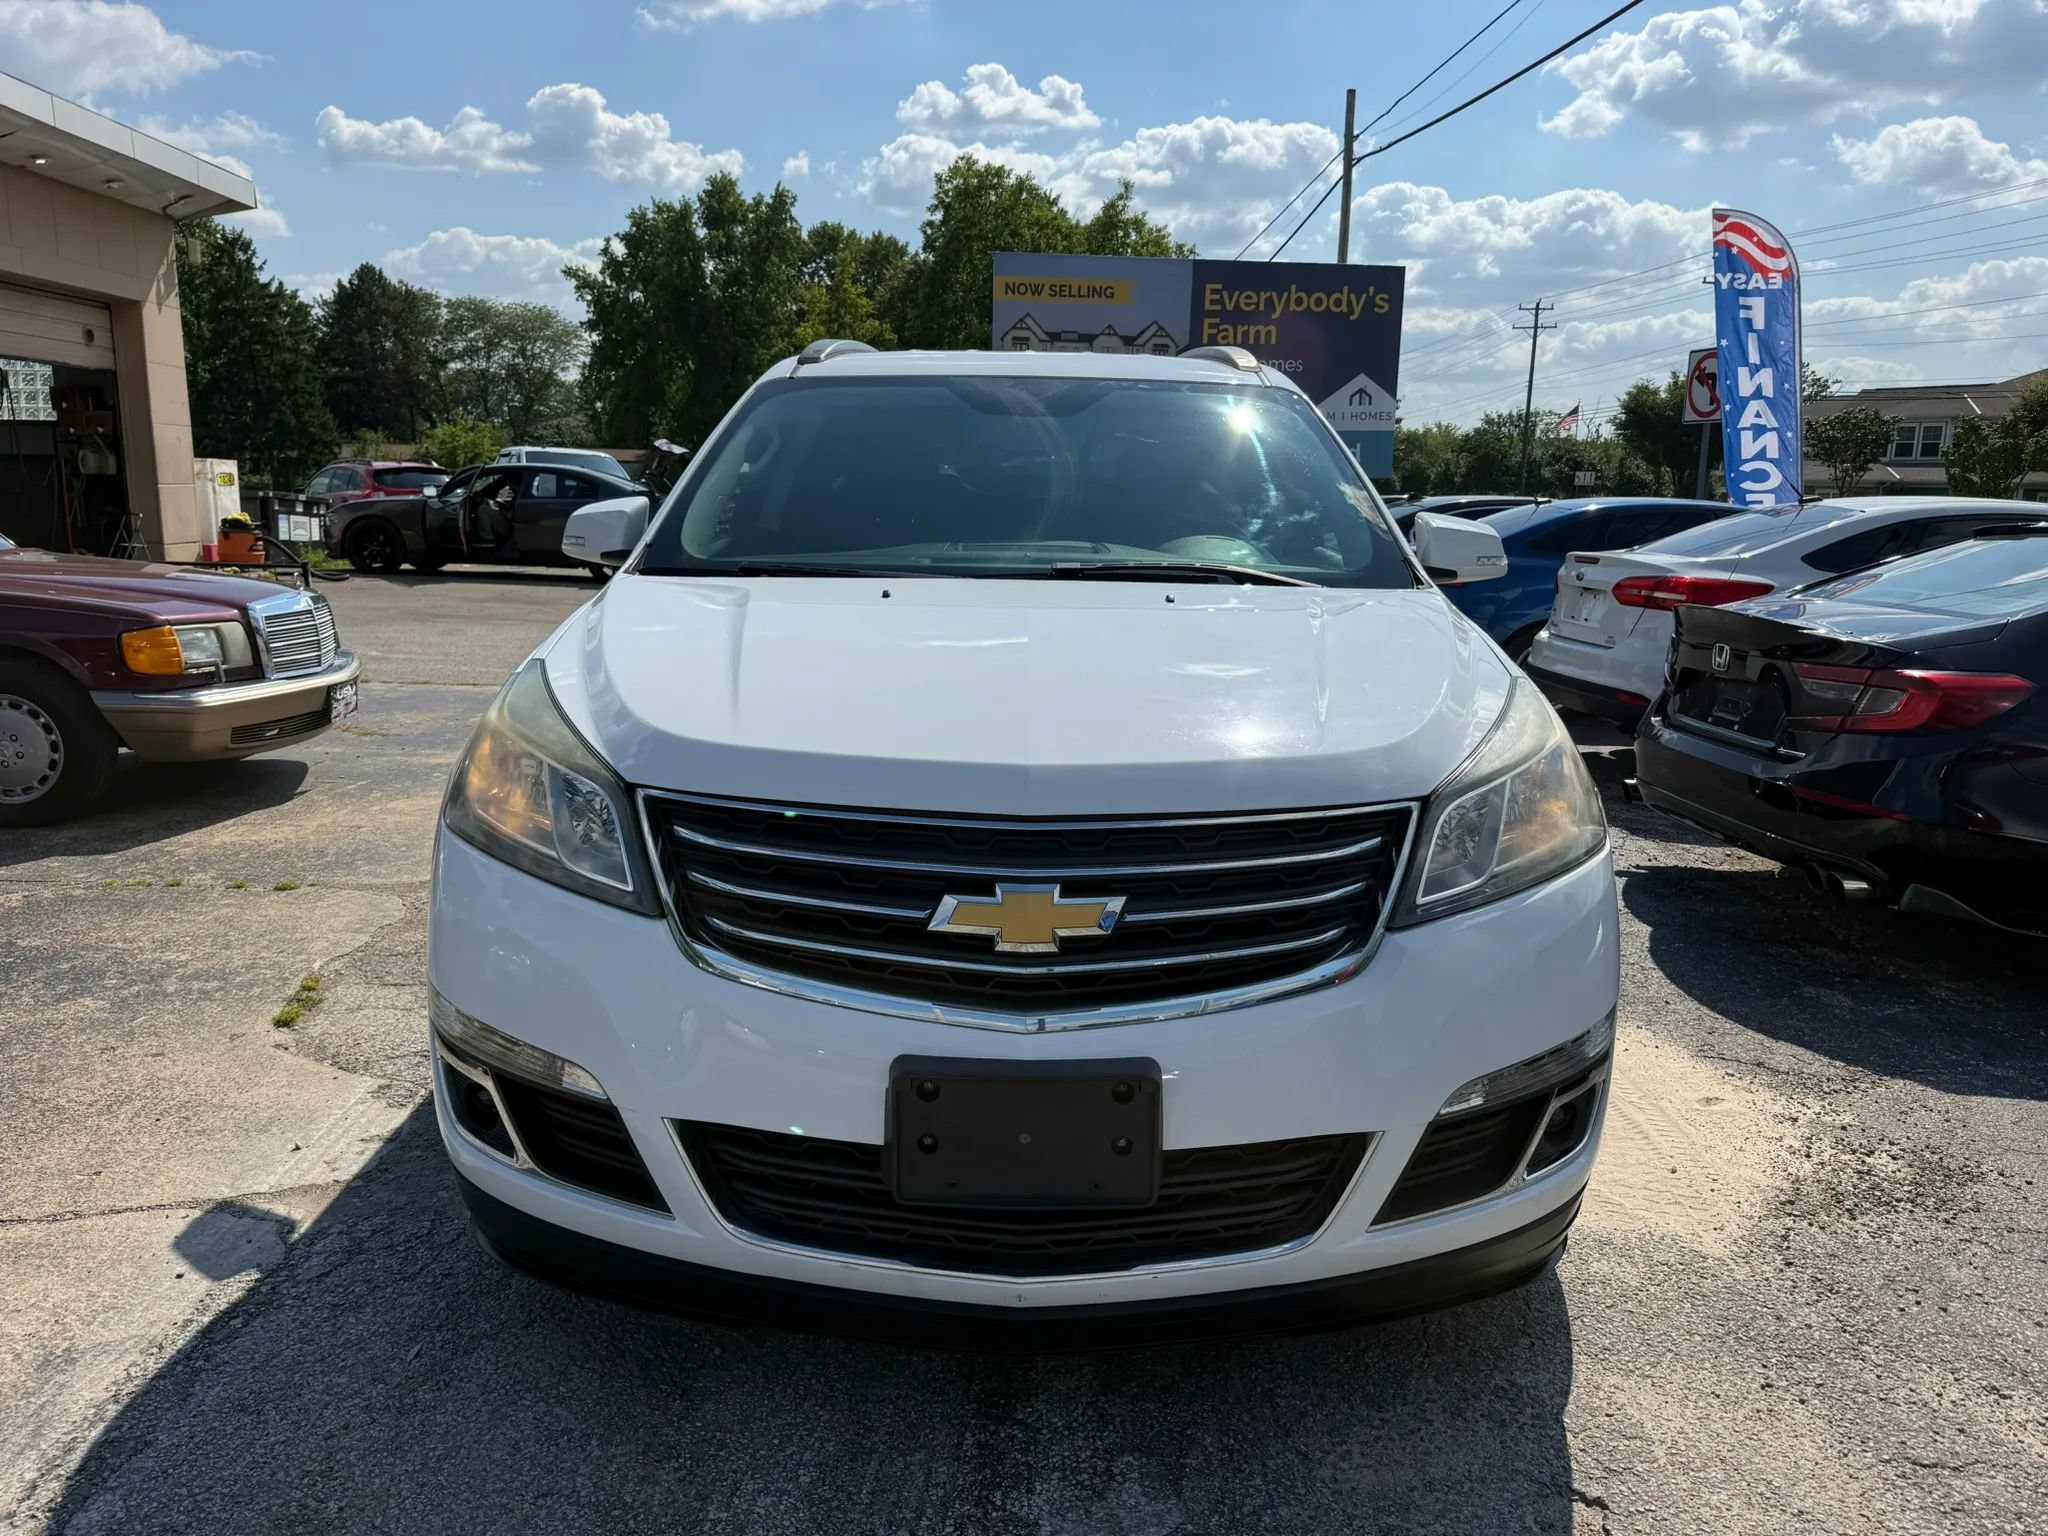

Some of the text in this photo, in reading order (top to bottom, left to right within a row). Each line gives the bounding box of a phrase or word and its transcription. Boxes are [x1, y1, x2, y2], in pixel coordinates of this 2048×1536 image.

[1004, 281, 1114, 299] NOW SELLING
[1204, 284, 1390, 321] Everybody's
[1202, 317, 1277, 345] Farm
[1326, 411, 1336, 421] M
[1350, 411, 1393, 421] HOMES
